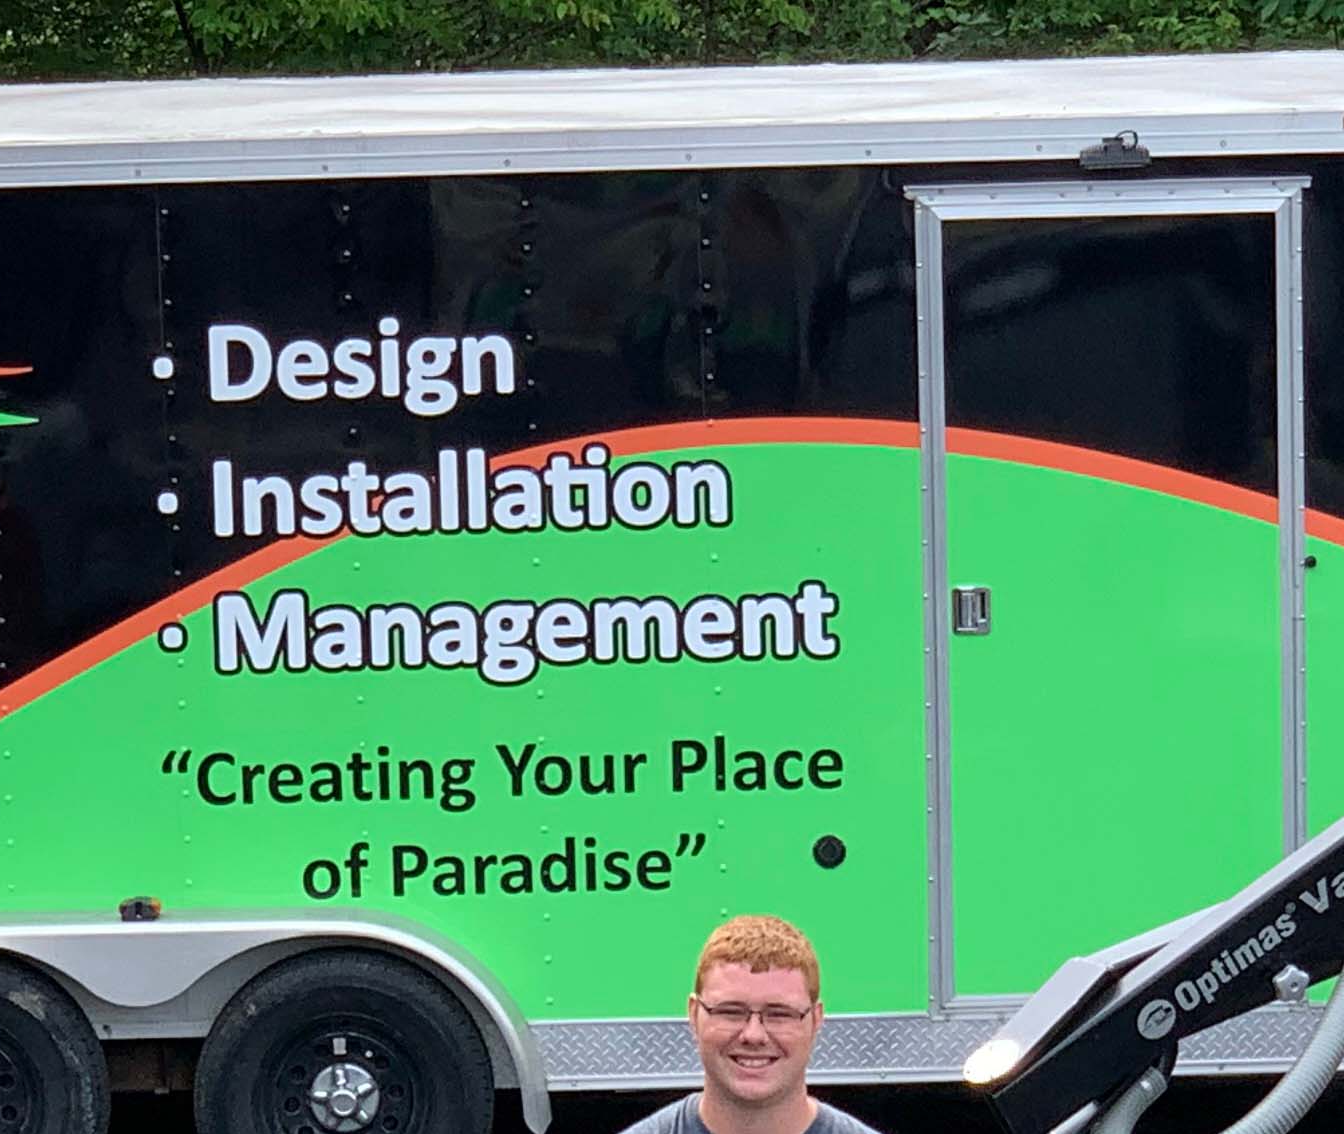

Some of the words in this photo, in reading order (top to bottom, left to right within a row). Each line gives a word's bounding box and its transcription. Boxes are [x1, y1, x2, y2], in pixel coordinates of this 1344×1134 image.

[208, 317, 516, 416] Design
[212, 443, 732, 537] Installation
[216, 582, 840, 685] Management
[161, 746, 476, 812] “Creating
[495, 743, 648, 798] Your
[670, 735, 845, 793] Place
[302, 843, 370, 898] of
[392, 833, 706, 897] Paradise”
[1174, 911, 1297, 1014] Optimas
